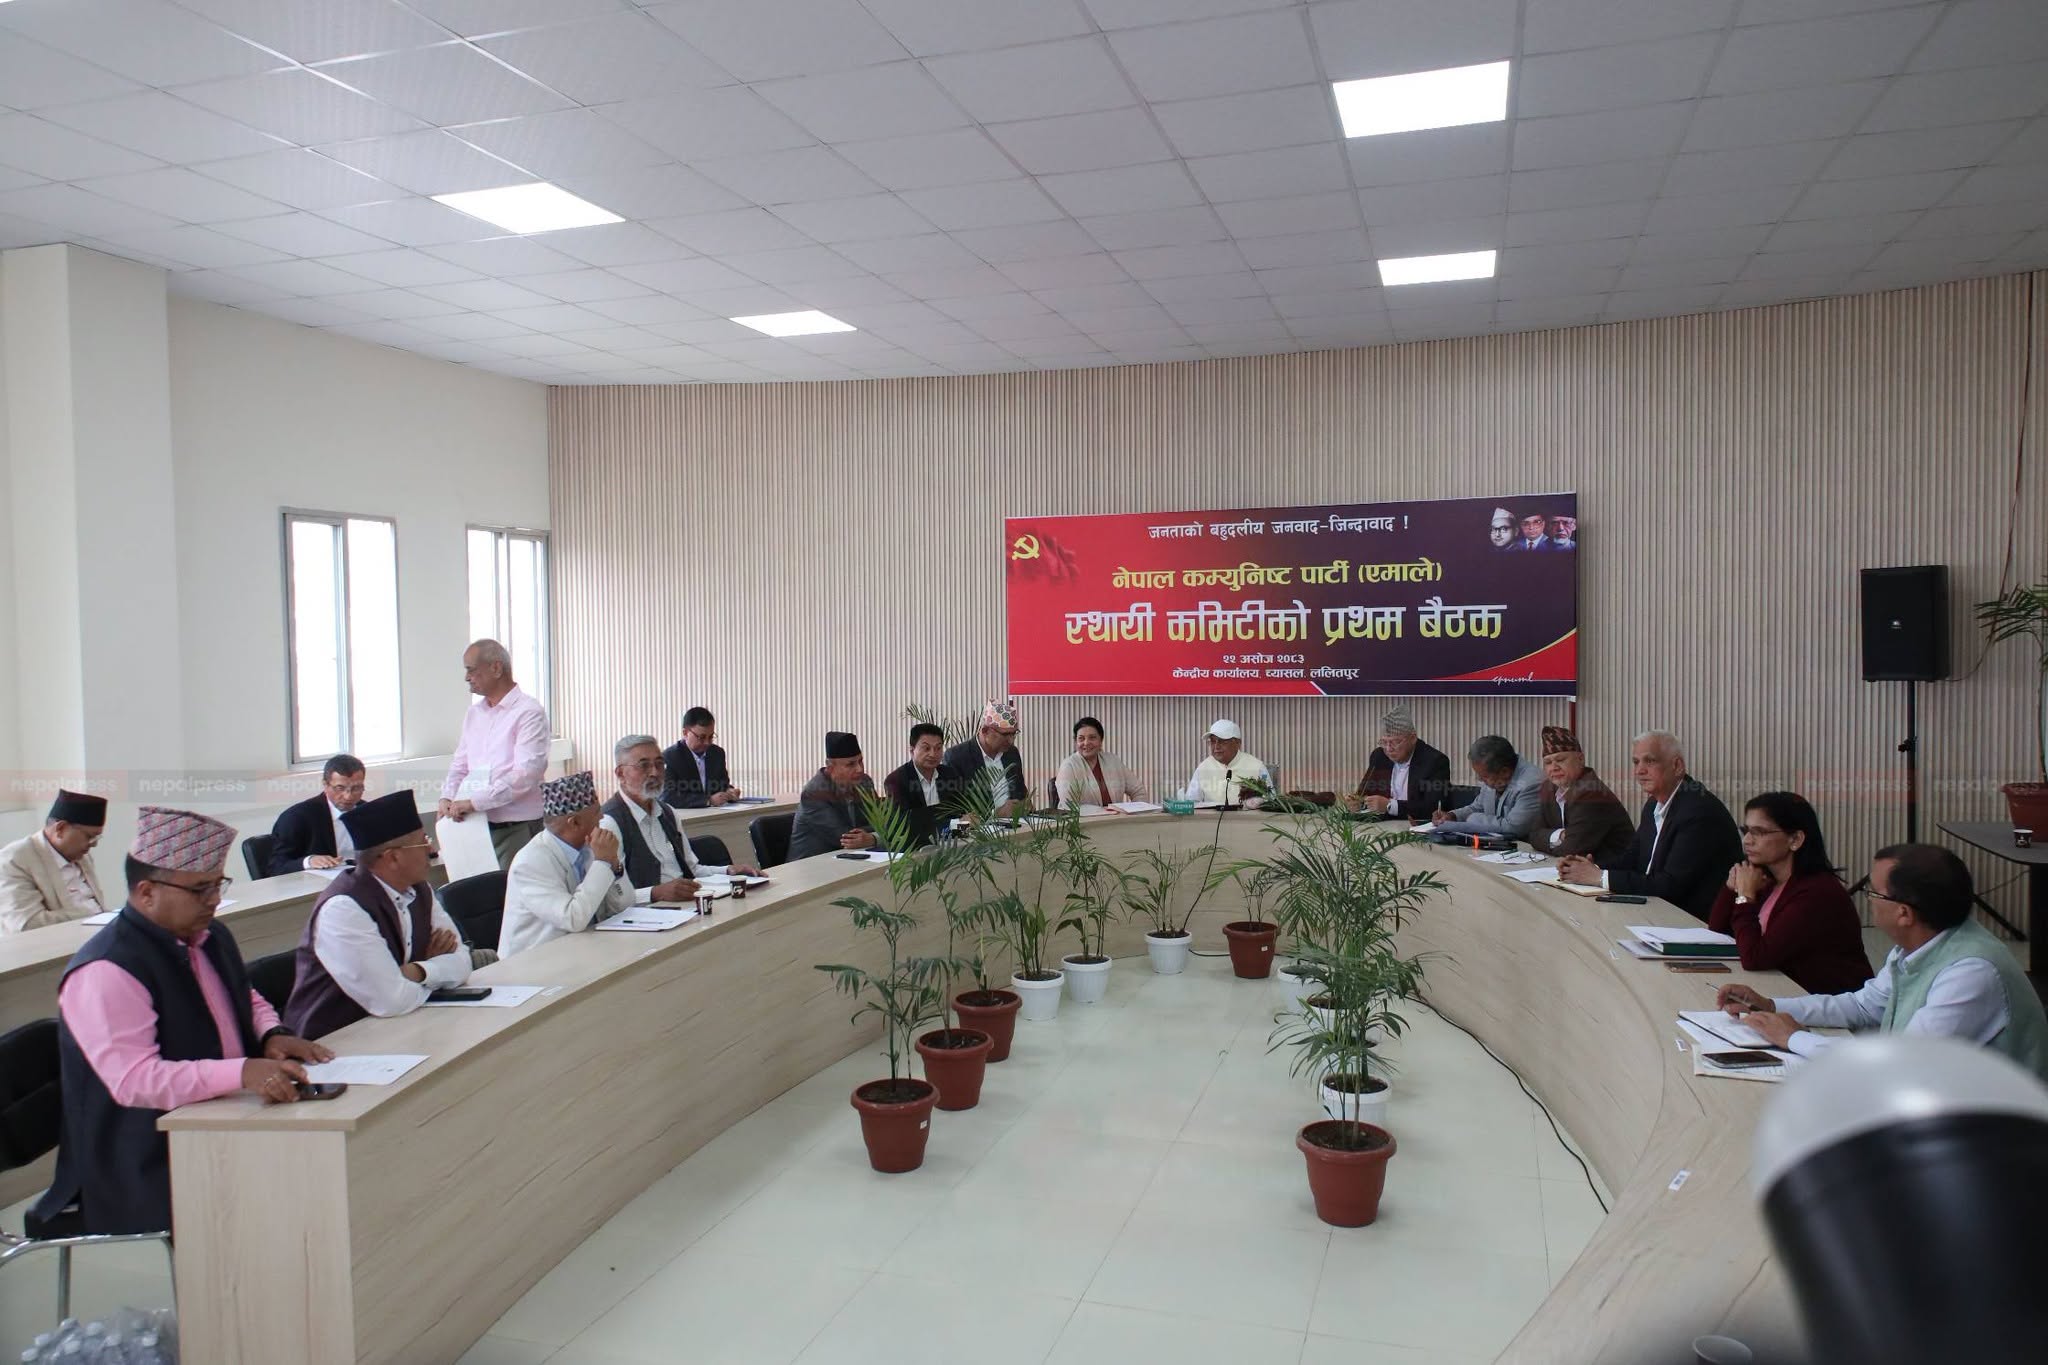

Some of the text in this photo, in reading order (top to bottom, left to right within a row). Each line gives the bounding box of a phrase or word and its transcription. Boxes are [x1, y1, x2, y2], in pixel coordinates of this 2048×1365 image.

[1148, 521, 1203, 539] जनताको
[1210, 518, 1265, 541] बहुदलीय
[1112, 557, 1442, 592] नेपाल कम्युनिष्ट पार्टी (एमाले)
[1065, 596, 1507, 647] स्थायी कमिटीको प्रथम बैठक
[1223, 652, 1305, 664] २२ असोज २०८३
[1172, 666, 1210, 679] केन्द्रीय
[1310, 665, 1361, 680] ललितपुर
